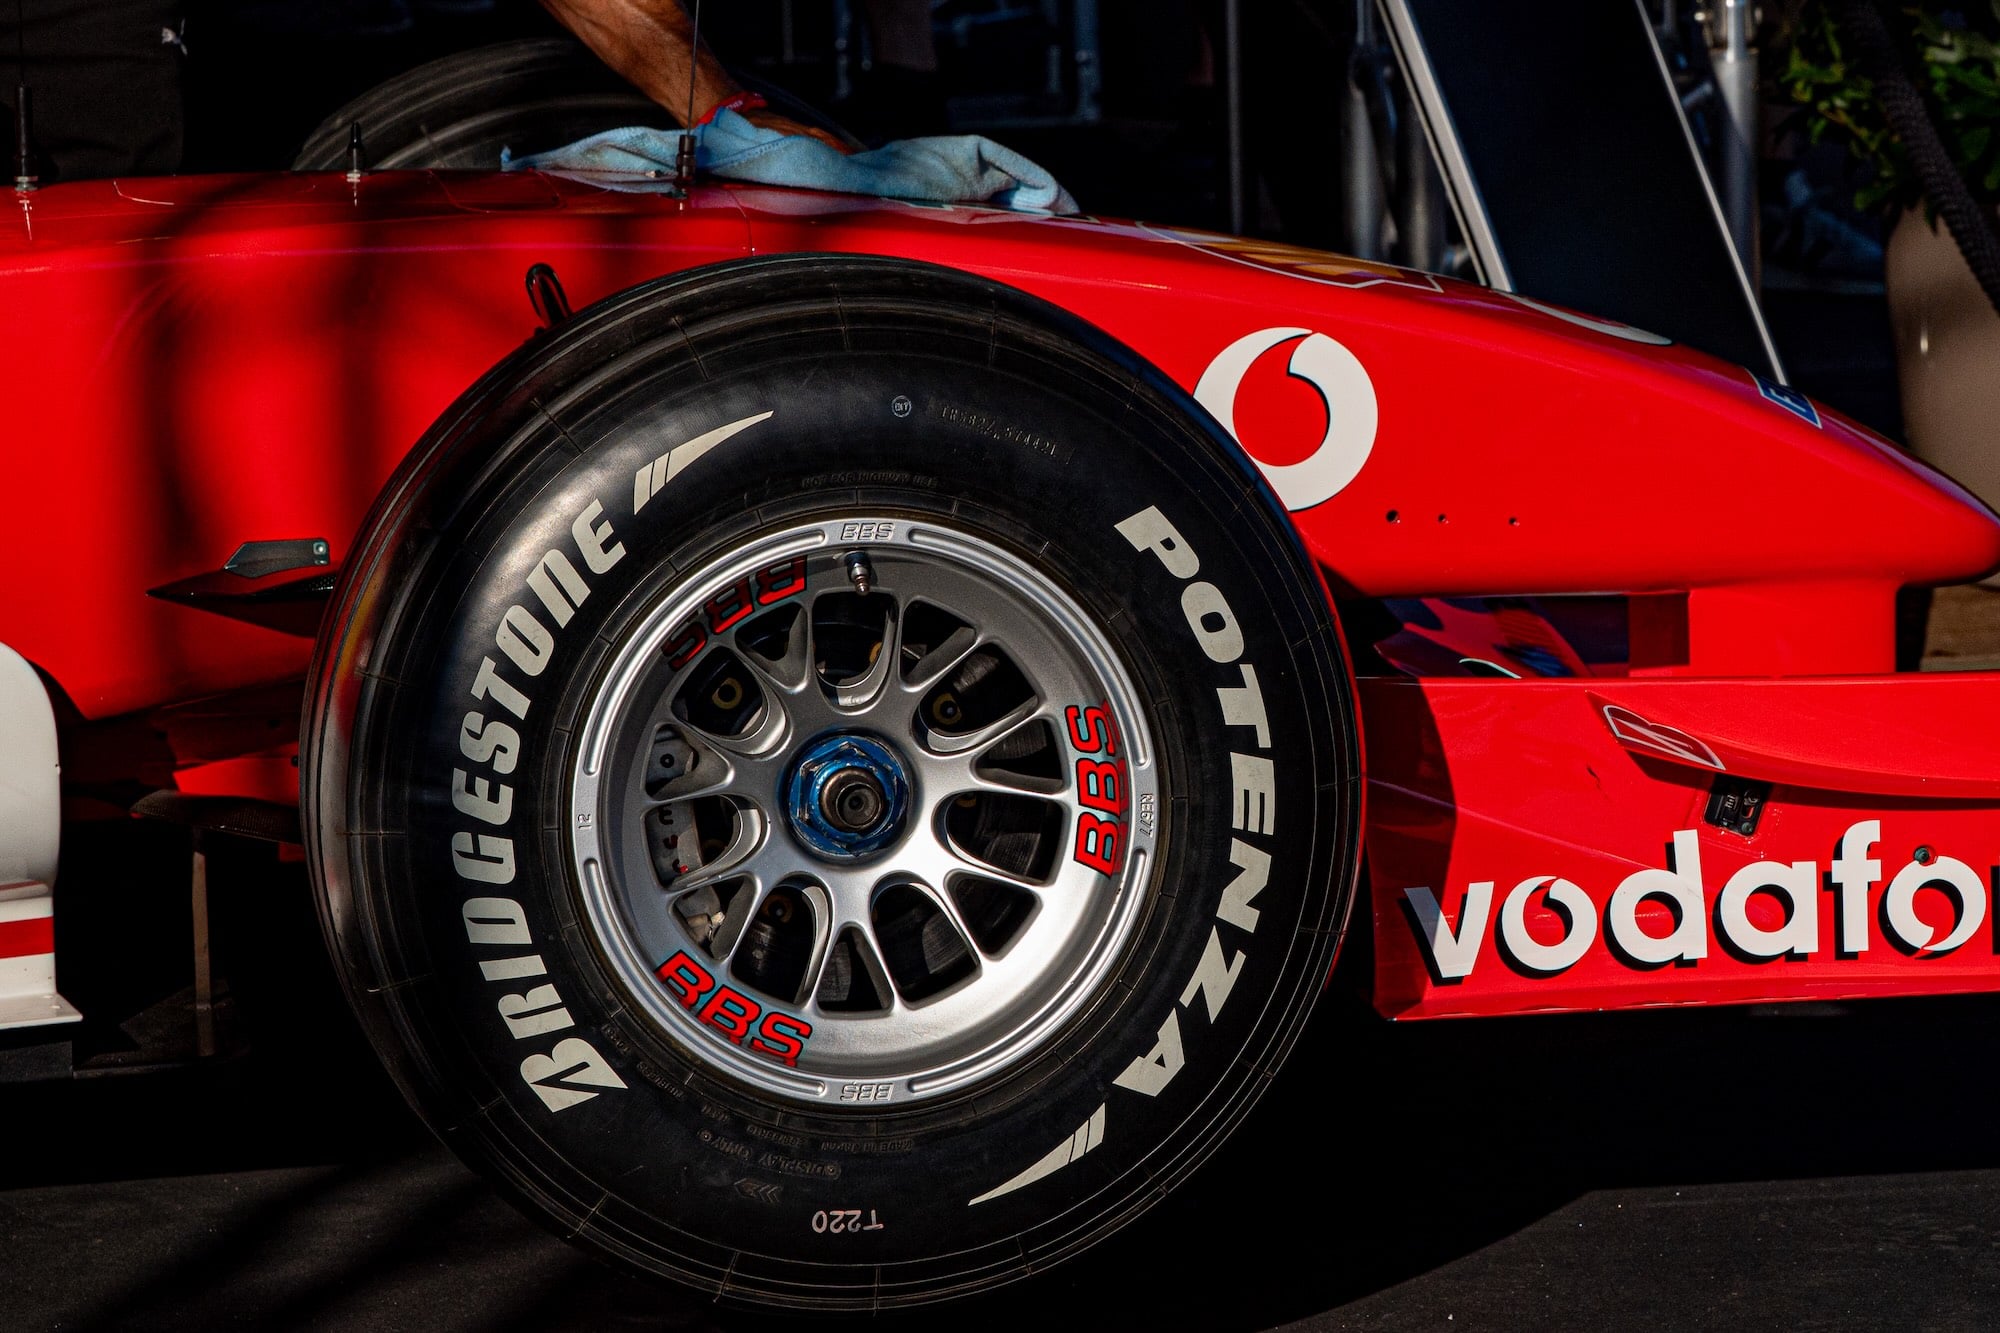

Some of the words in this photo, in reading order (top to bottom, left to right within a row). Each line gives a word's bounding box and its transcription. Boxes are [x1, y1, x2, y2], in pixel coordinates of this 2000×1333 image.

[840, 522, 894, 541] BBS
[660, 555, 808, 672] BBS
[452, 498, 632, 1114] BRIDGESTONE
[1064, 704, 1121, 878] BBS
[1113, 504, 1277, 1099] POTENZA
[1403, 820, 2000, 986] vodafo
[658, 949, 812, 1067] BBS
[840, 1082, 894, 1102] BBS
[811, 1207, 885, 1234] T220
